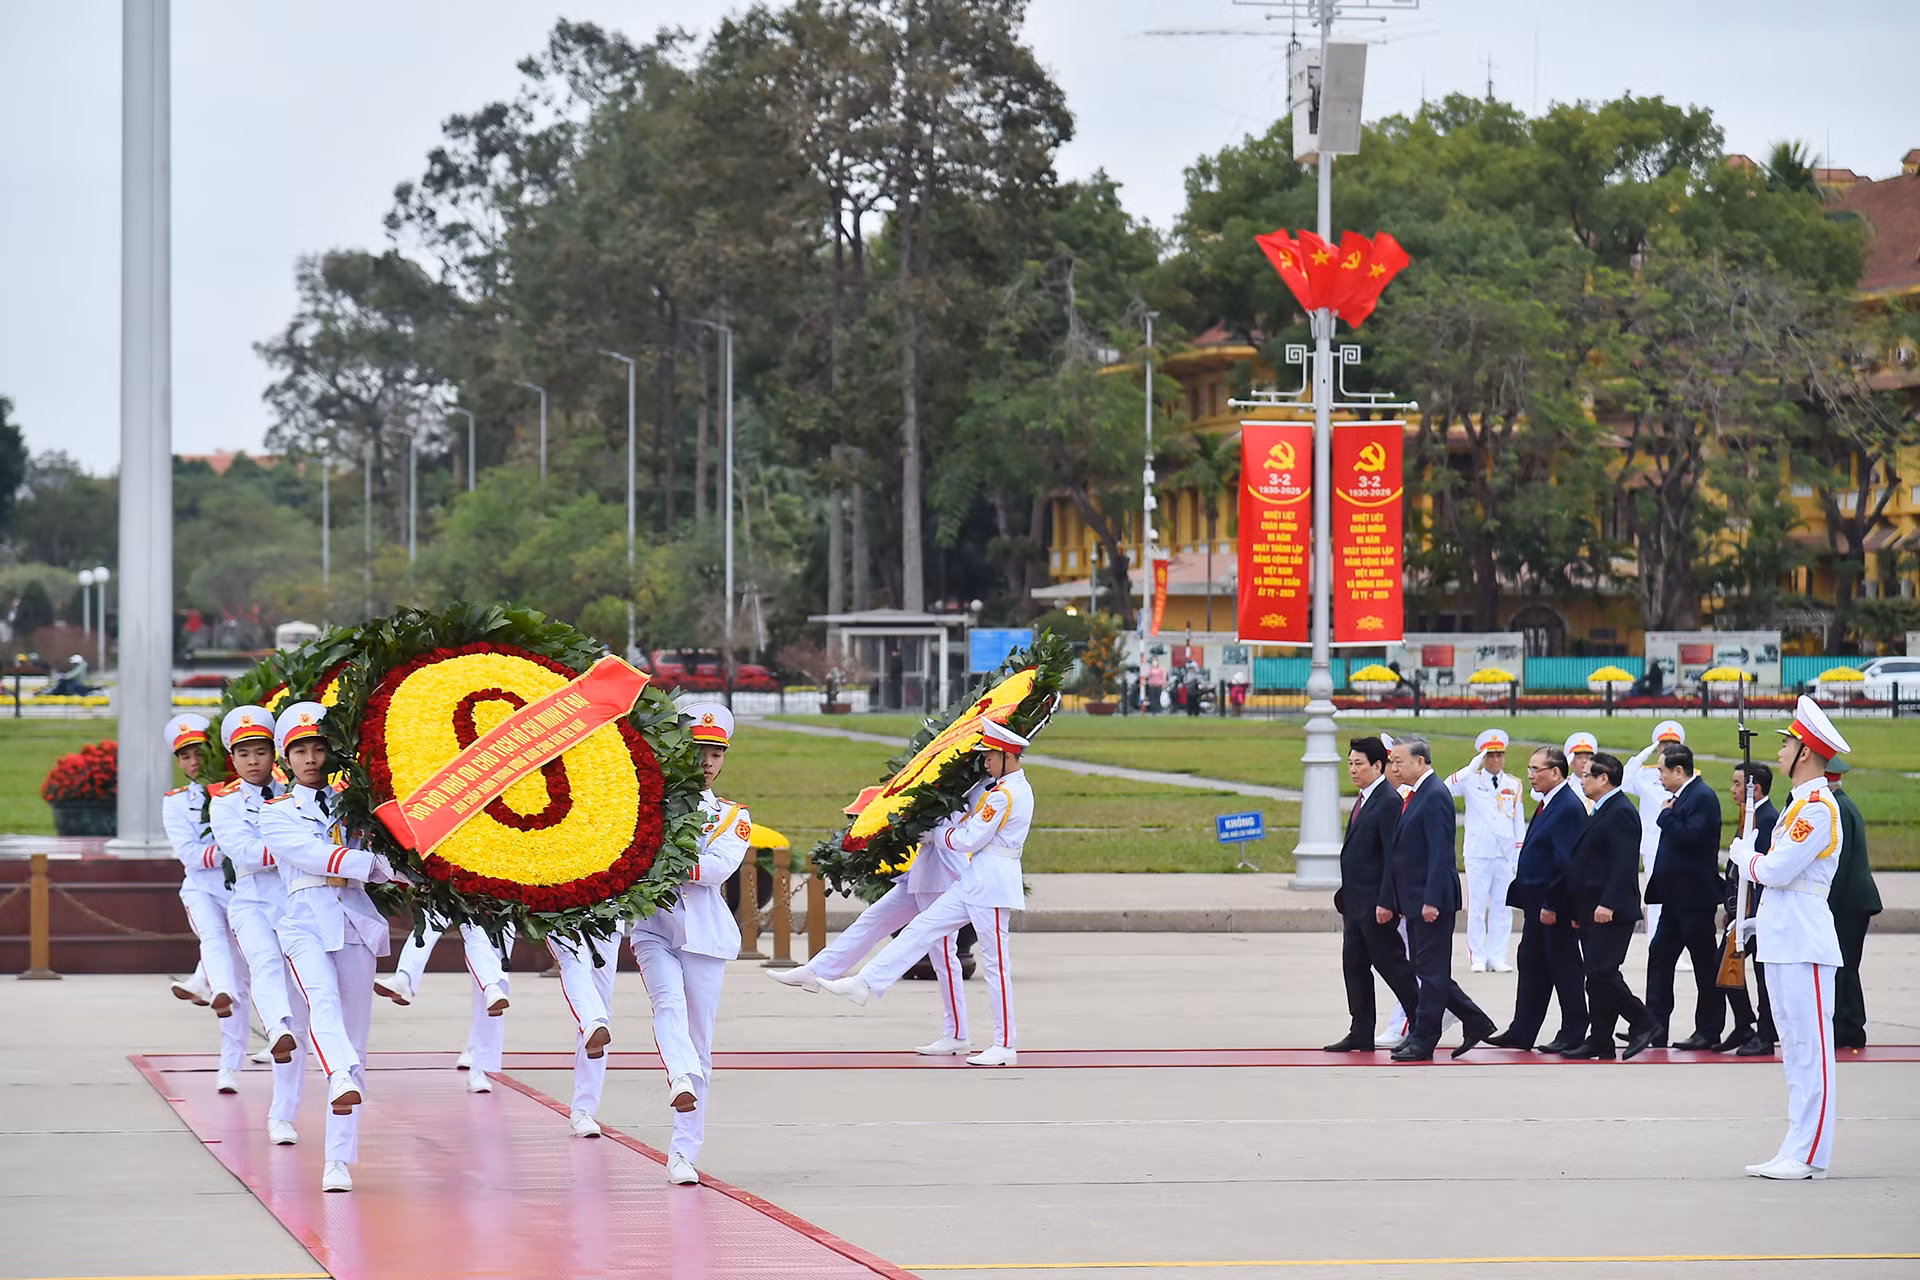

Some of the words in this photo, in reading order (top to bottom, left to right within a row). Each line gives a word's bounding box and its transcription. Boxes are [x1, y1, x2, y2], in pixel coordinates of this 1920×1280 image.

[1269, 473, 1291, 485] 3-2
[1358, 475, 1381, 488] 3-2
[554, 698, 577, 715] VĨ
[564, 691, 591, 708] ĐẠI
[520, 716, 546, 738] CHÍ
[534, 705, 568, 730] MINH
[507, 722, 532, 745] HỒ
[488, 735, 520, 757] TỊCH
[450, 799, 470, 815] BAN
[462, 789, 483, 806] CHẤP
[547, 731, 567, 746] SẢN
[558, 726, 577, 739] VIỆT
[568, 718, 588, 734] NAM
[470, 746, 500, 771] CHỦ
[457, 763, 483, 782] ƠN
[437, 772, 468, 797] NHỚ
[421, 789, 450, 809] ĐỜI
[406, 802, 435, 821] ĐỜI
